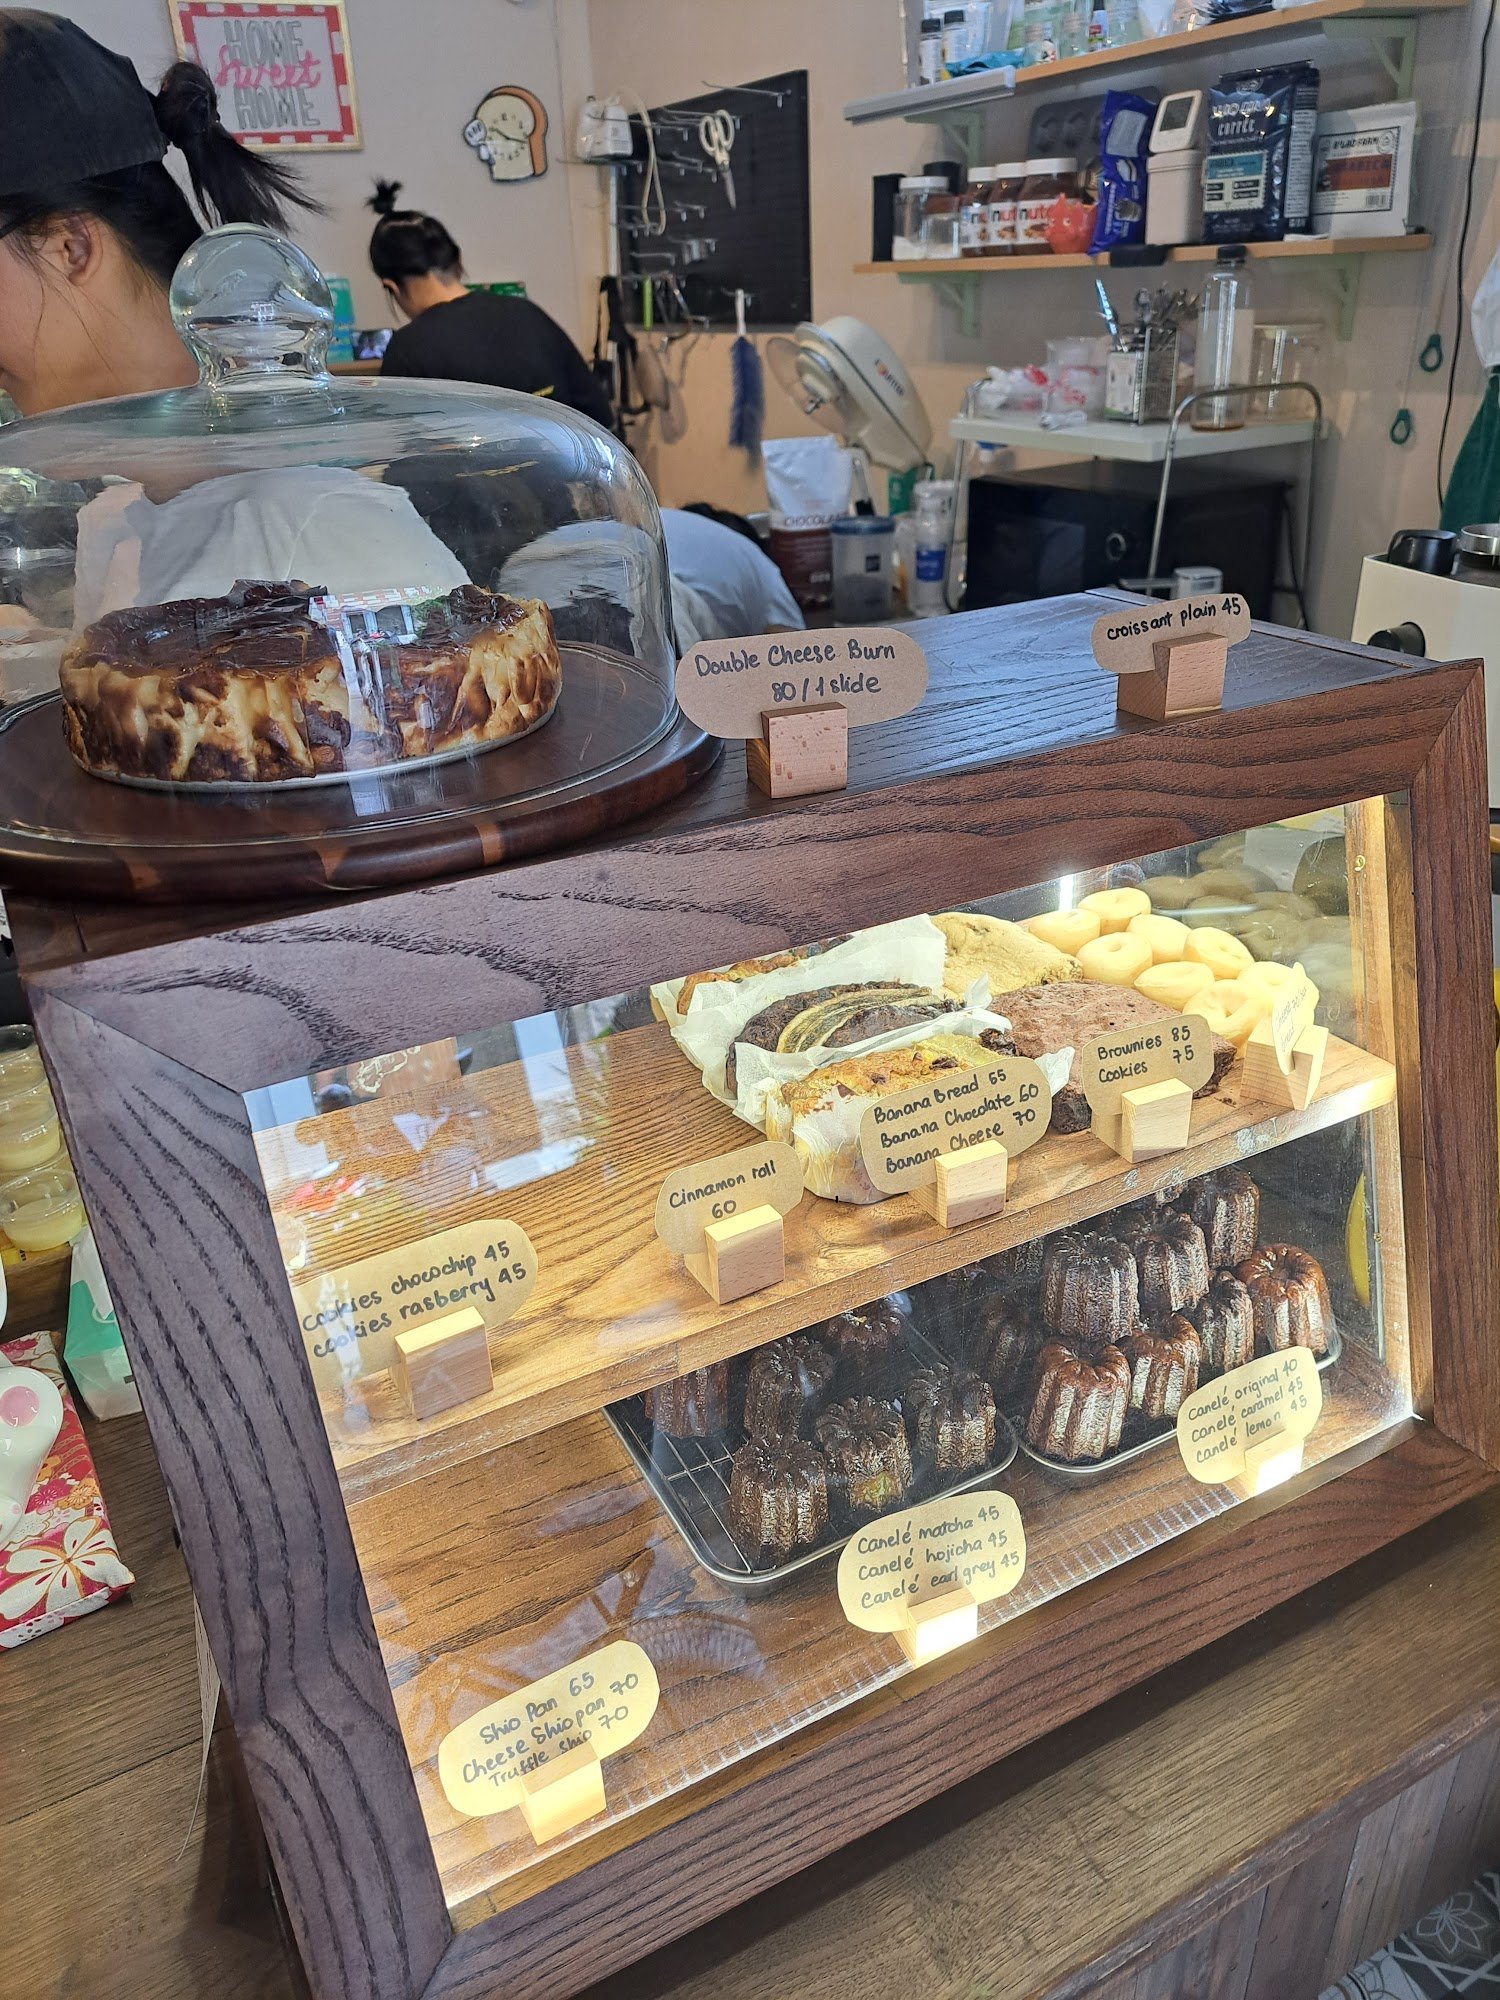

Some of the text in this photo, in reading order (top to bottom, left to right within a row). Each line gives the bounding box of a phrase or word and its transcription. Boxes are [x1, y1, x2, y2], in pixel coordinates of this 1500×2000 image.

[223, 20, 303, 67] HOME
[233, 85, 321, 129] HOME
[1106, 597, 1241, 640] croissant plain 45
[694, 638, 895, 677] Double Cheese Burn
[1097, 1025, 1191, 1061] Brownies 85
[1098, 1044, 1194, 1083] Cookies 75
[873, 1068, 1007, 1124] Banana Bread 65
[880, 1083, 1039, 1149] Banana Chocolate 60
[886, 1108, 1036, 1174] Banana Cheese 70
[669, 1159, 776, 1209] Cinnamon roll
[711, 1199, 737, 1219] 60
[390, 1254, 476, 1295] chocochip
[484, 1240, 510, 1262] 45
[399, 1277, 496, 1320] rasberry
[499, 1262, 527, 1284] 45
[1234, 1368, 1278, 1399] original
[1282, 1358, 1298, 1376] 40
[1241, 1386, 1284, 1419] caramel
[1287, 1376, 1304, 1396] 45
[1245, 1411, 1281, 1438] lemon
[1290, 1394, 1308, 1412] 45
[918, 1516, 974, 1540] matcha
[977, 1505, 1000, 1522] 45
[925, 1538, 983, 1564] hojicha
[987, 1530, 1008, 1548] 45
[930, 1565, 959, 1588] earl
[962, 1558, 996, 1586] grey
[1000, 1550, 1020, 1568] 45
[462, 1738, 530, 1784] Cheese
[609, 1672, 639, 1696] 70
[479, 1716, 521, 1746] Shio
[568, 1671, 596, 1697] 65
[488, 1750, 550, 1787] Truffle
[597, 1705, 630, 1730] 70
